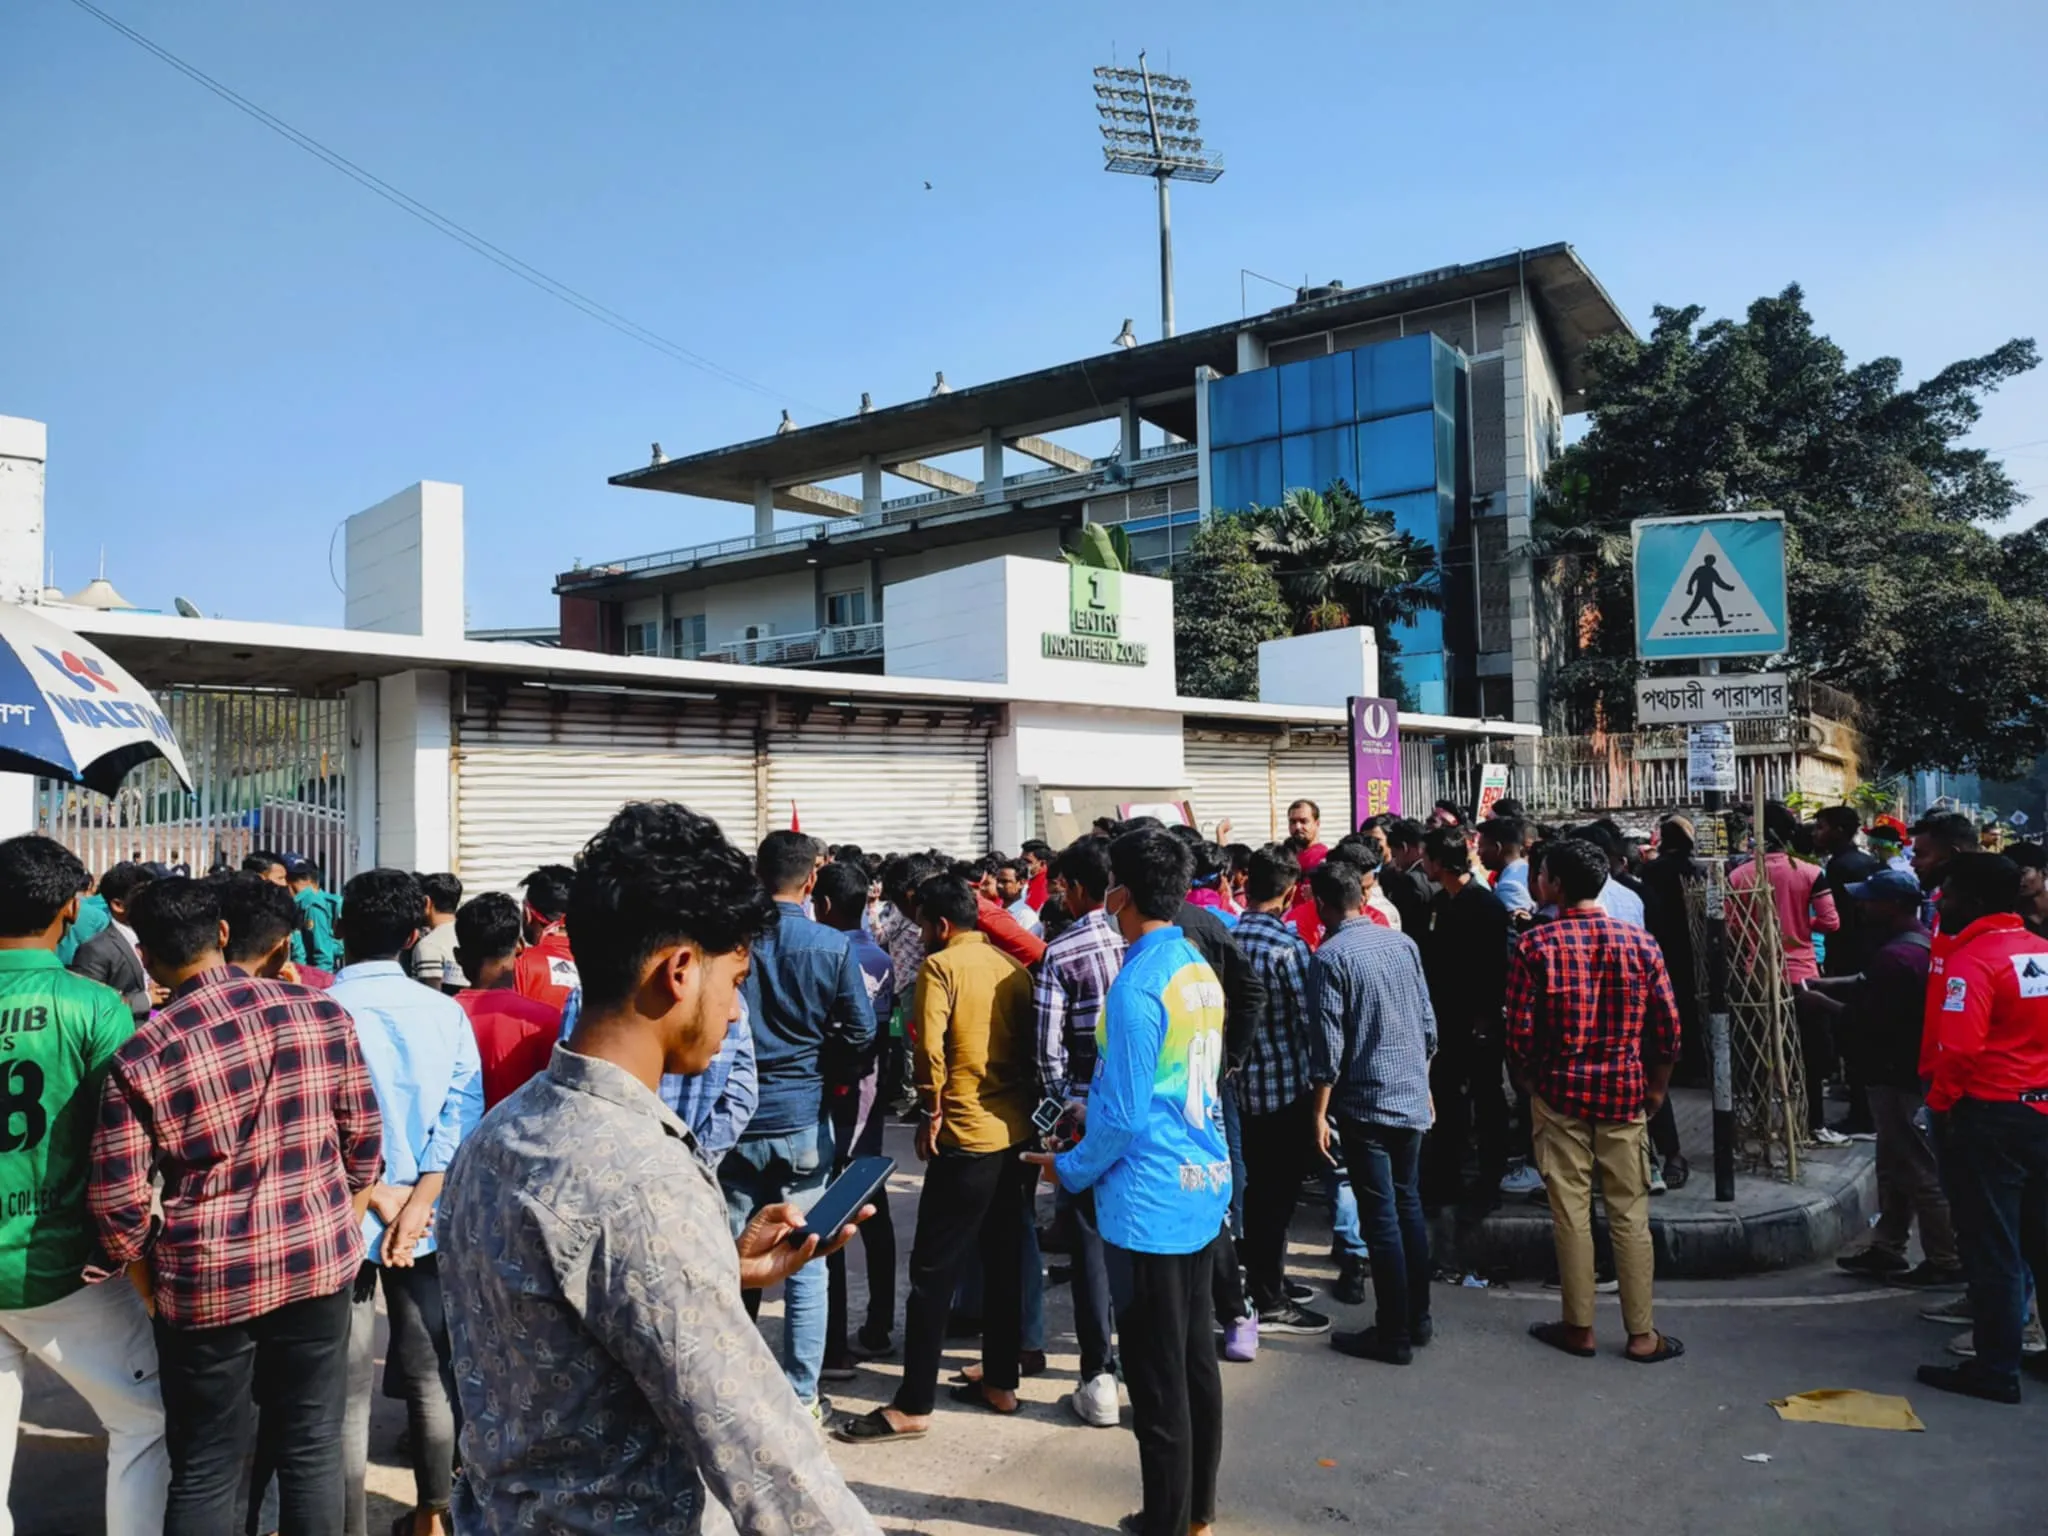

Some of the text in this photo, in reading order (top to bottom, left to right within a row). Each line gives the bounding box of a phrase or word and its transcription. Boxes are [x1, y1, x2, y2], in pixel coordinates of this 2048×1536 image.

[1087, 571, 1107, 609] 1
[1074, 609, 1120, 633] ENTRY
[1047, 633, 1147, 664] NORTHERN ZONE
[1641, 680, 1785, 711] পথচারী পারাপার
[45, 690, 176, 746] WALTON
